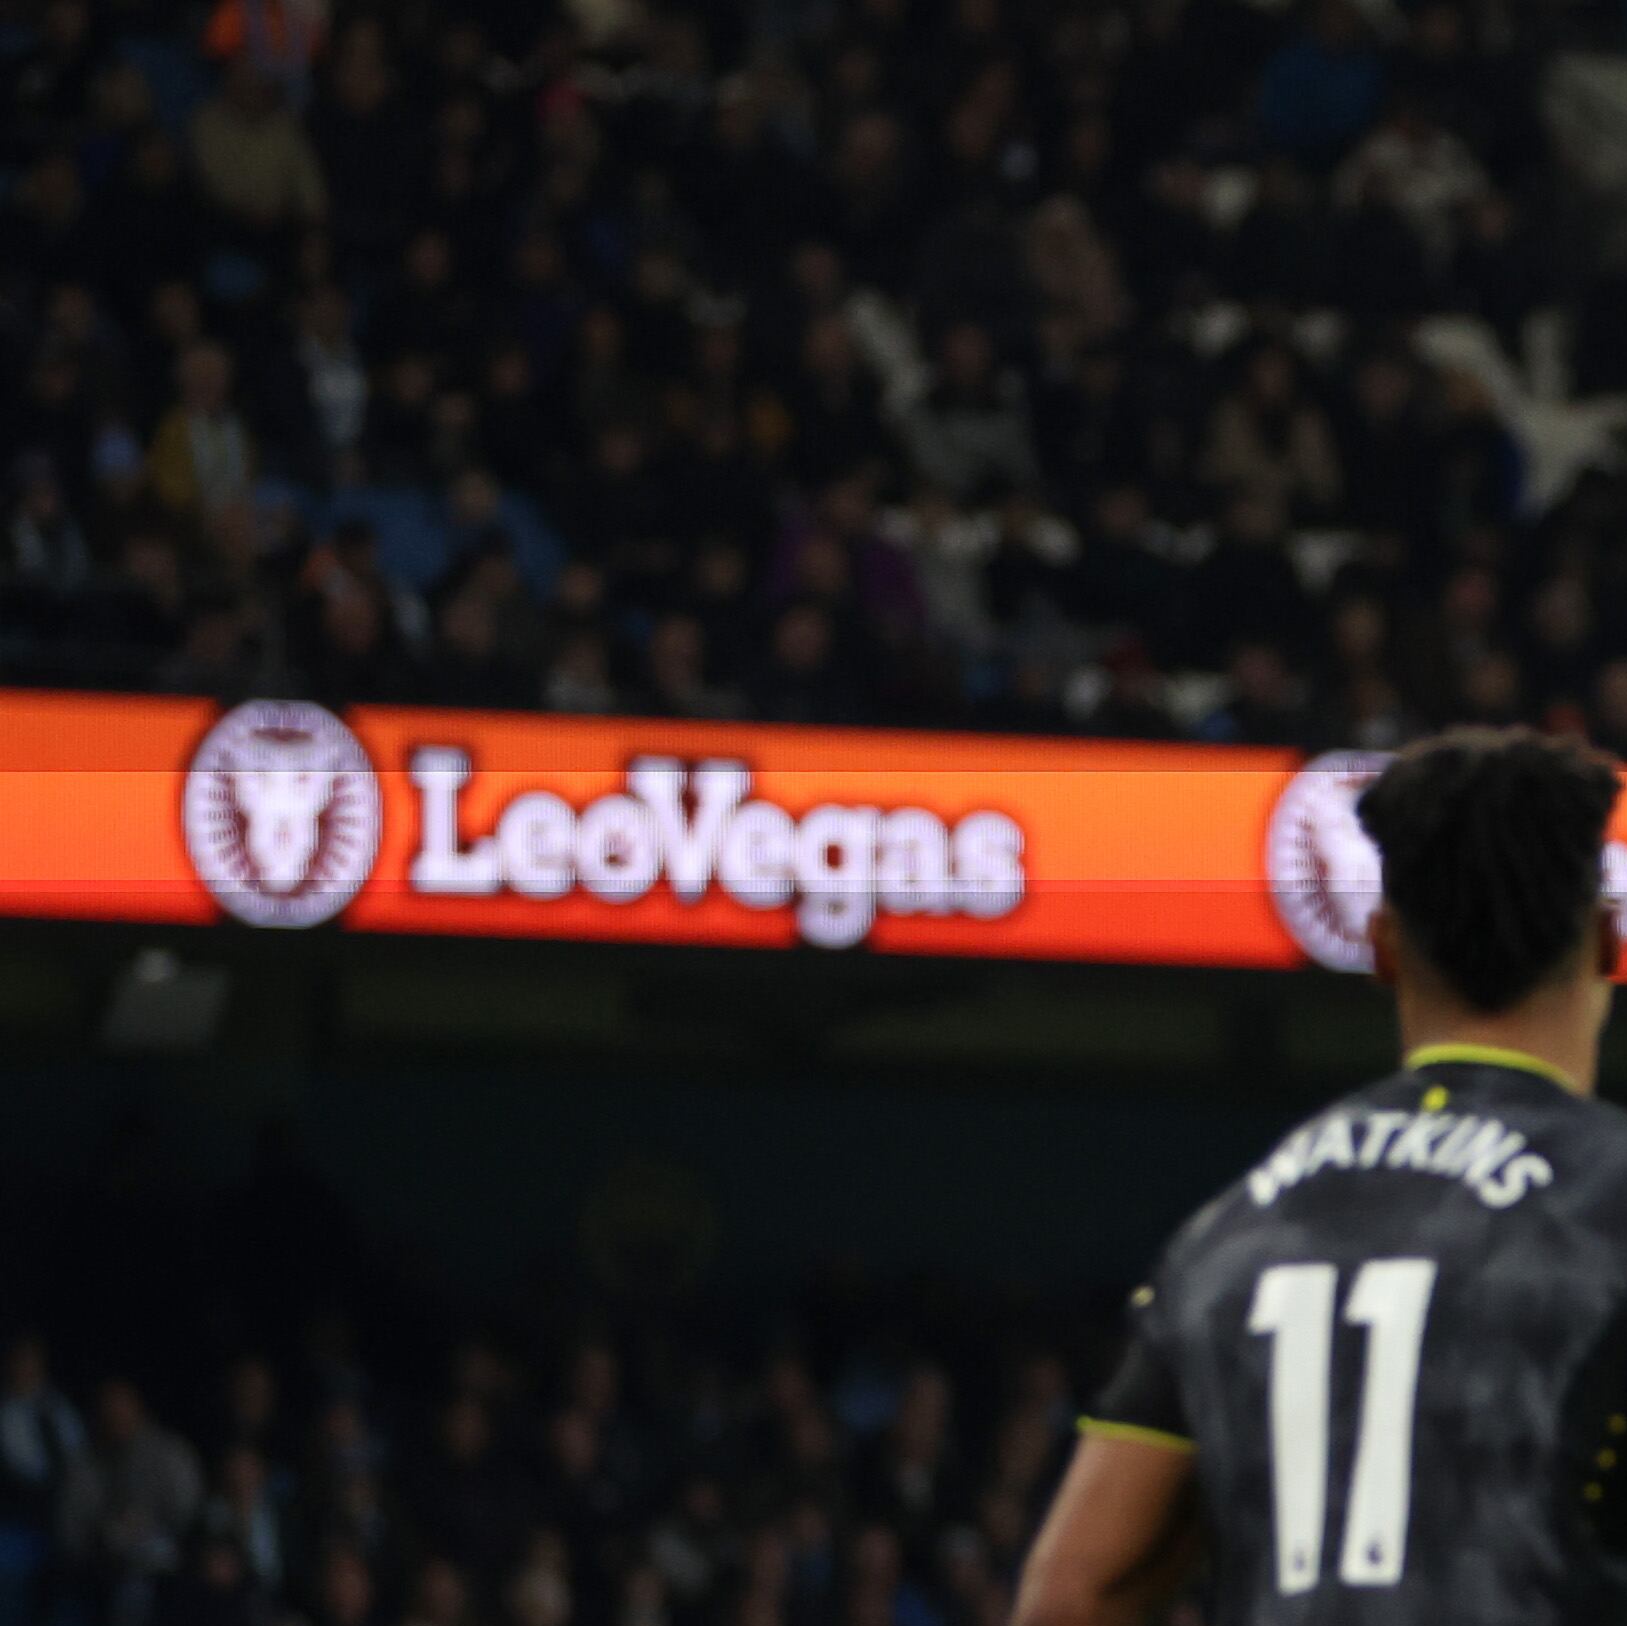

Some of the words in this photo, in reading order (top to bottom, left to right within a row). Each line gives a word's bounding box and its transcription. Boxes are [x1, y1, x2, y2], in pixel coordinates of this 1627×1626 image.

[411, 745, 1025, 949] LeoVegas
[1246, 1110, 1553, 1209] WATKINS
[1246, 1256, 1439, 1596] 11
